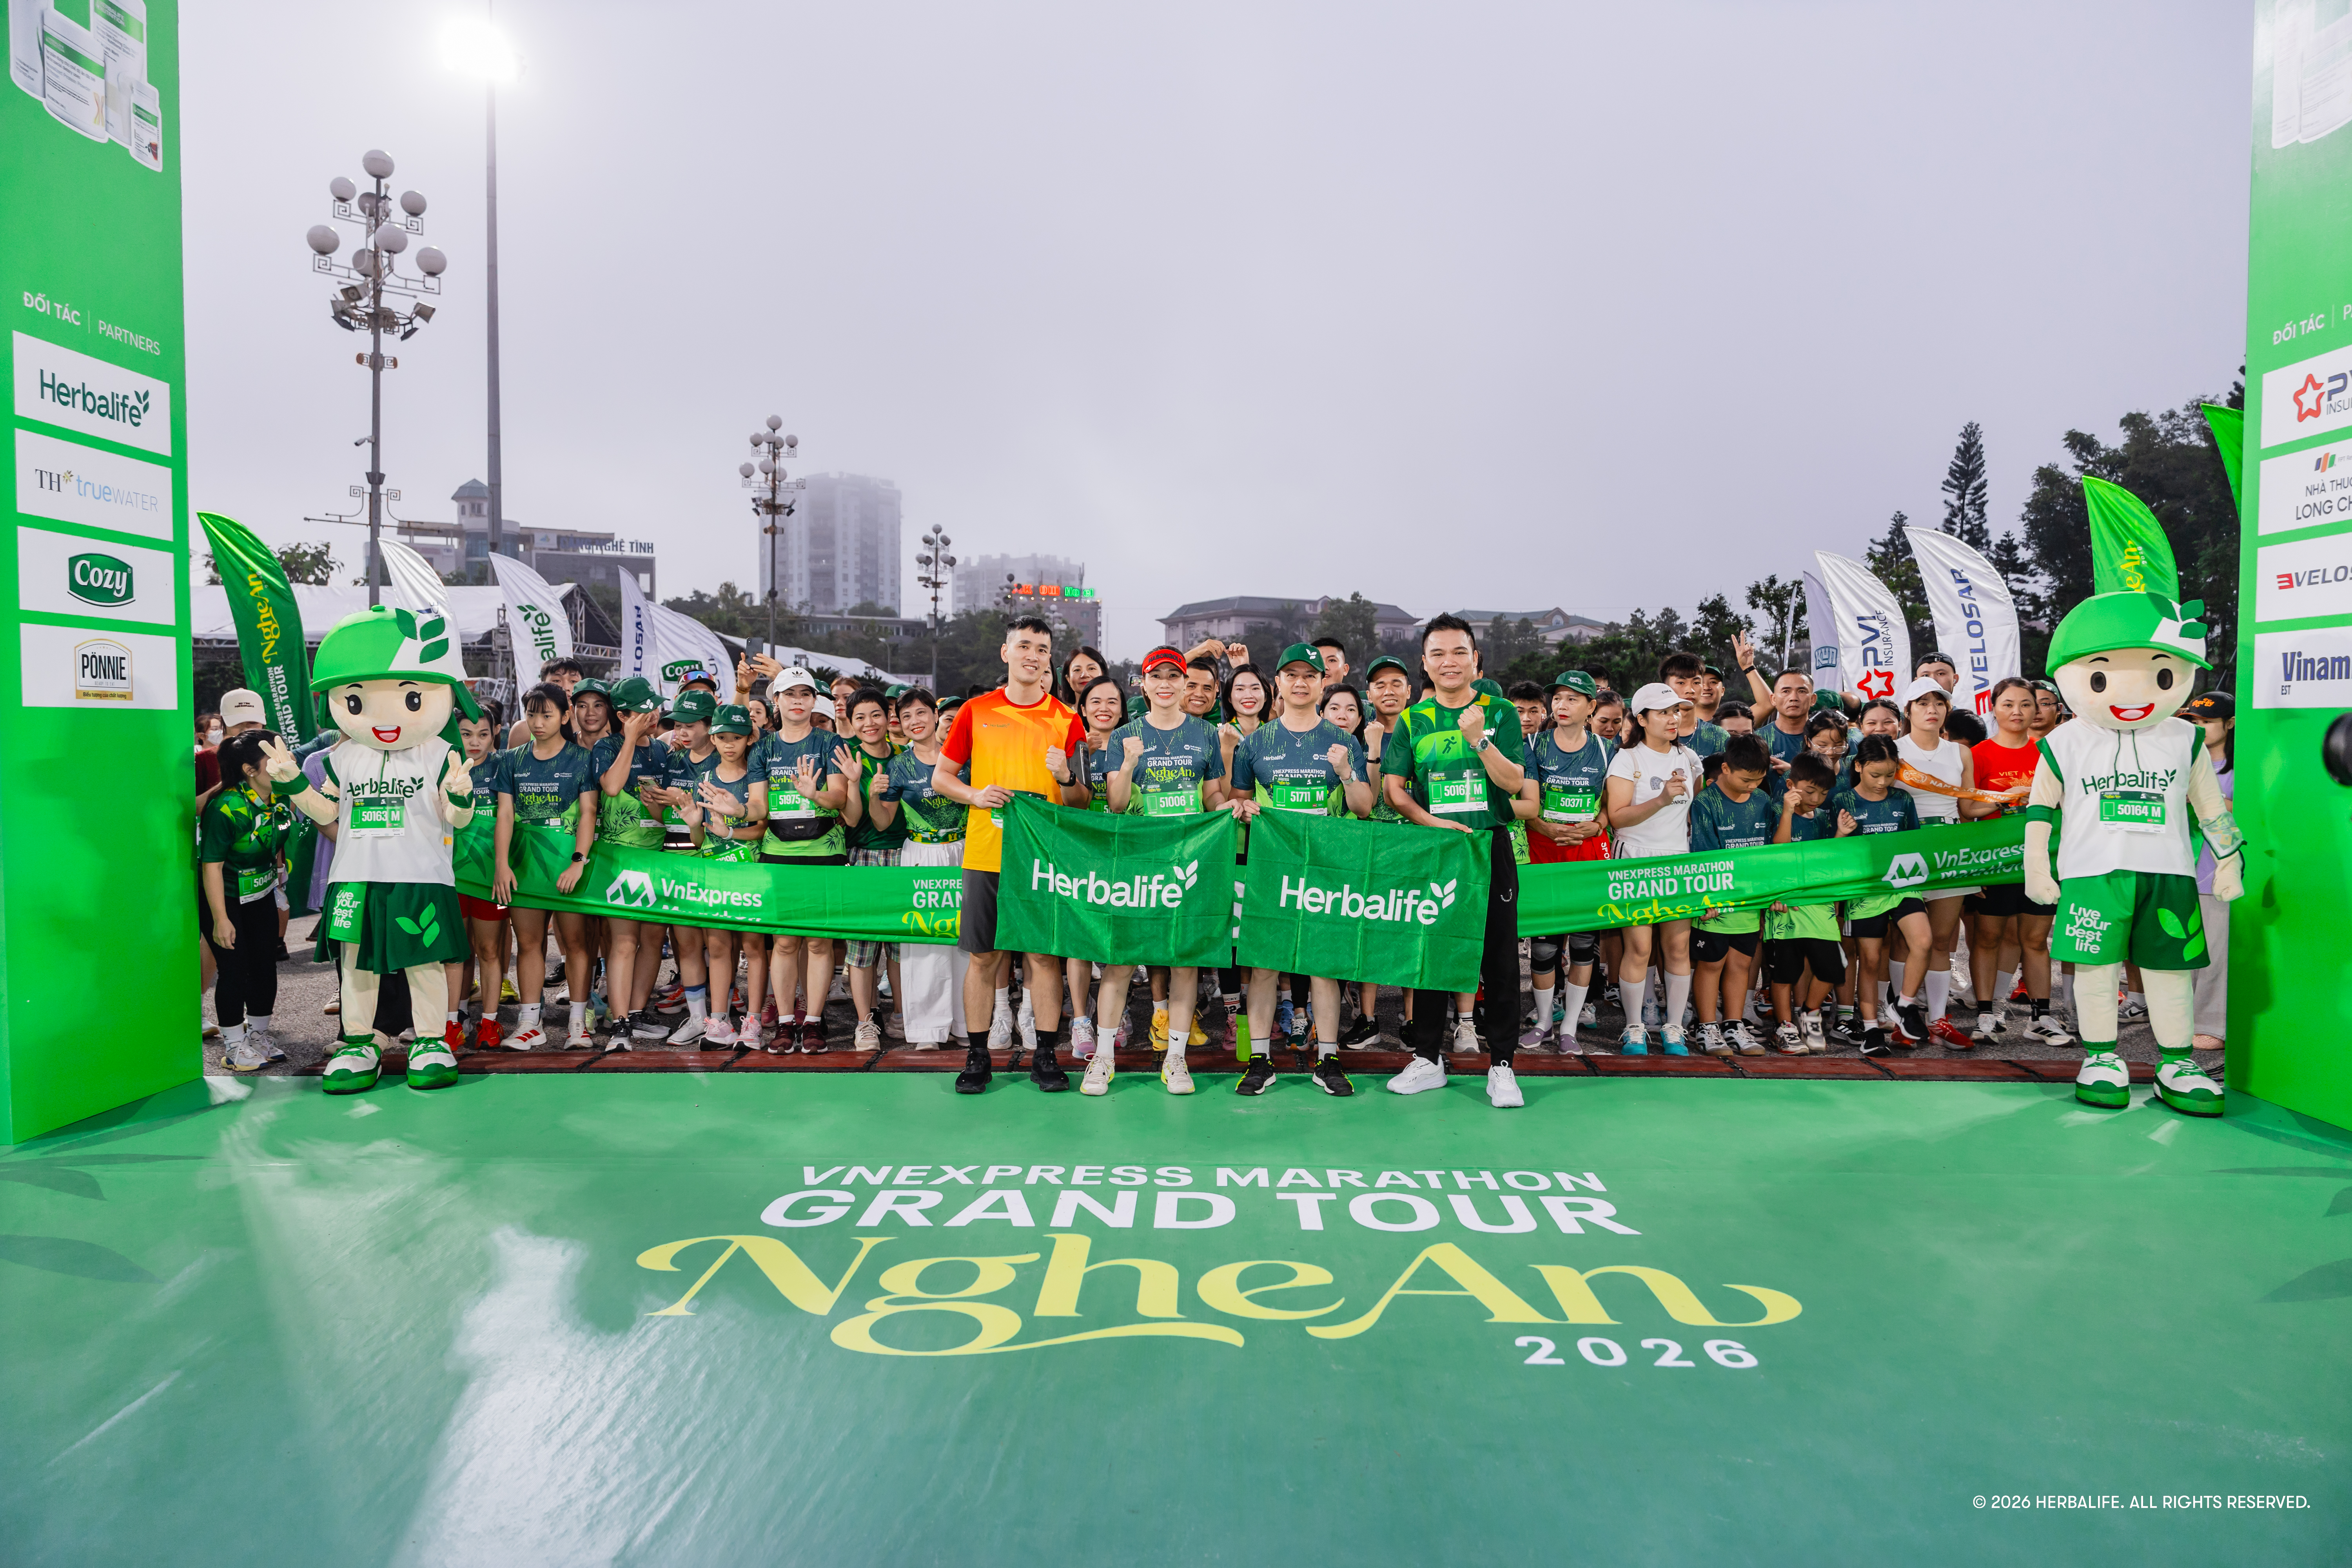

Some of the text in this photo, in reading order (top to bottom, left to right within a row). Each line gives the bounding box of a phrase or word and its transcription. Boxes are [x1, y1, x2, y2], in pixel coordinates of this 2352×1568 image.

[23, 291, 160, 355] ĐỐI TÁC PARTNERS
[2273, 321, 2296, 345] ĐỐI
[2299, 313, 2325, 335] TÁC
[40, 368, 142, 427] Herbalife
[2327, 397, 2352, 415] INSU
[35, 469, 62, 493] TH
[2306, 479, 2327, 497] NHÀ
[2296, 499, 2333, 520] LONG
[74, 560, 127, 597] Cozy
[2294, 565, 2352, 587] VELO
[248, 566, 280, 664] NgheAn
[1875, 610, 1893, 666] INSURANCE
[1950, 568, 1989, 690] VELOSAR
[1857, 615, 1883, 667] PVI
[82, 652, 126, 680] PÖNNIE
[2282, 651, 2352, 681] Vinam
[267, 667, 281, 710] MARATHON
[274, 664, 289, 702] TOUR
[2281, 685, 2291, 695] EST
[1146, 766, 1195, 781] NgheAn
[1546, 777, 1570, 785] GRAND
[2082, 770, 2168, 795] Herbalife
[346, 777, 415, 800] Herbalife
[518, 792, 561, 806] NgheAn
[1290, 790, 1324, 802] 51711 M
[1444, 784, 1482, 797] 50162 M
[779, 794, 801, 805] 51975
[1160, 795, 1194, 808] 51006 F
[1560, 797, 1591, 808] 50371 F
[362, 811, 400, 822] 50163 M
[2118, 804, 2161, 817] 50164 M
[739, 850, 744, 859] F
[1601, 842, 1610, 860] SPO
[1934, 844, 2025, 869] VnExpress
[1608, 860, 1734, 881] VNEXPRESS MARATHON
[661, 878, 762, 907] VnExpress
[913, 879, 962, 889] VNEXPRE
[1032, 858, 1182, 908] Herbalife
[1608, 873, 1734, 900] GRAND TOUR
[336, 889, 354, 900] Live
[337, 897, 361, 910] your
[913, 891, 962, 908] GRAN
[1280, 875, 1439, 925] Herbalife
[2069, 903, 2102, 918] Live
[334, 916, 352, 929] life
[2065, 924, 2102, 941] best
[2075, 914, 2111, 932] your
[2075, 938, 2101, 954] life
[803, 1165, 1608, 1192] VNEXPRESS MARATHON
[760, 1189, 1643, 1235] GRAND TOUR
[636, 1233, 1802, 1356] NgheAn
[1514, 1335, 1759, 1369] 2026
